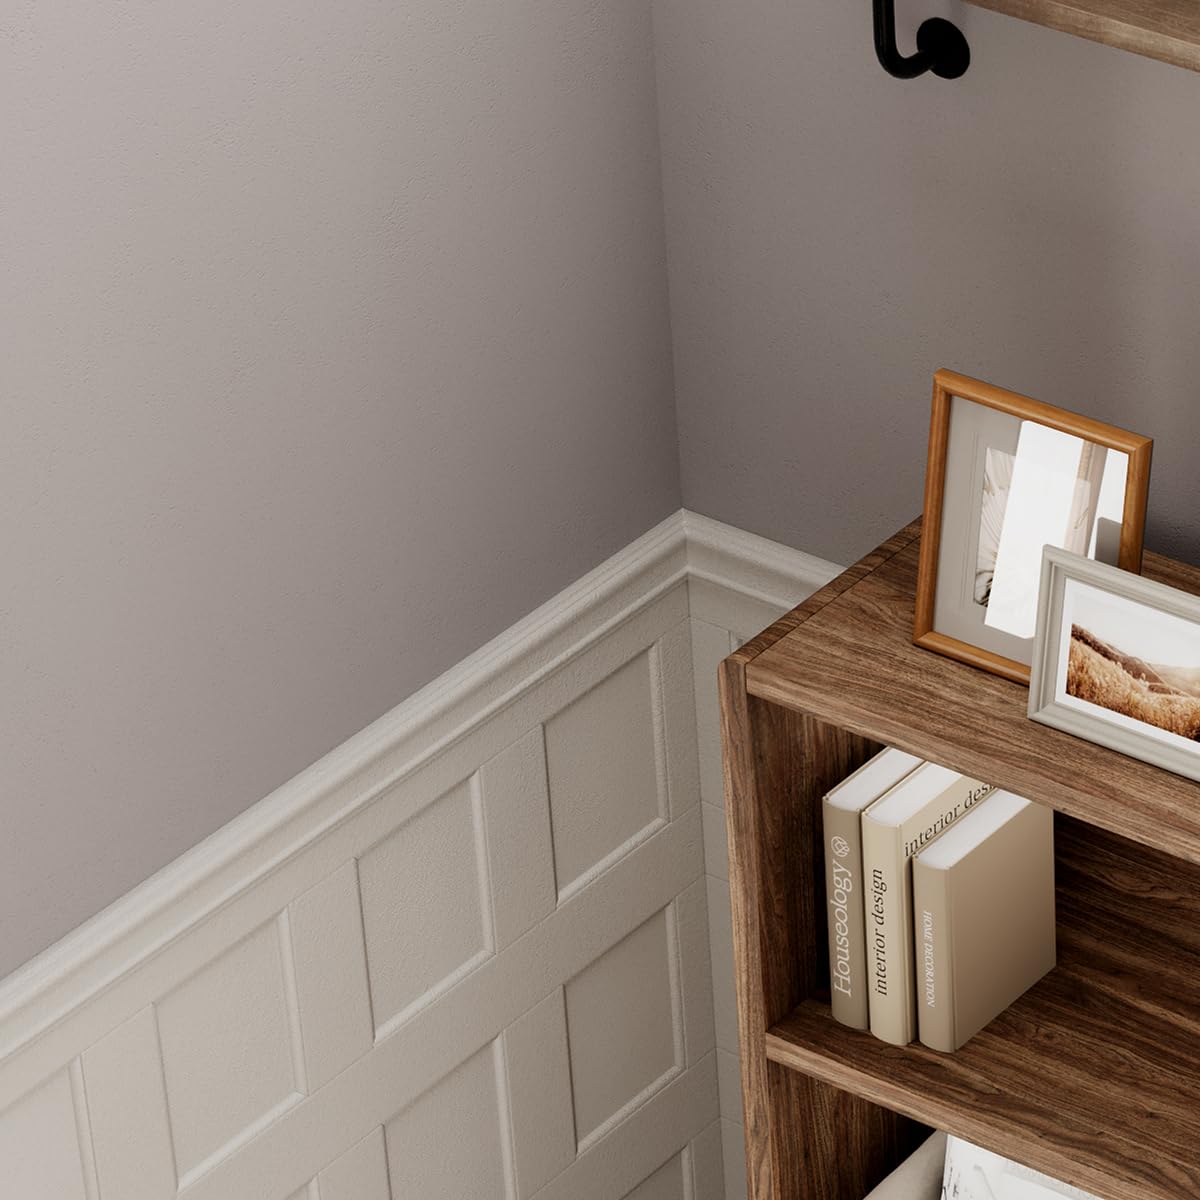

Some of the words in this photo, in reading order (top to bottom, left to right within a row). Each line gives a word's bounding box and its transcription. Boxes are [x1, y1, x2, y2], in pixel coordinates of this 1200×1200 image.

[904, 804, 961, 857] interior
[831, 858, 852, 998] Houseology
[872, 868, 887, 927] design
[924, 910, 933, 944] HOME
[875, 930, 888, 997] interior
[926, 943, 935, 1008] DECORATION
